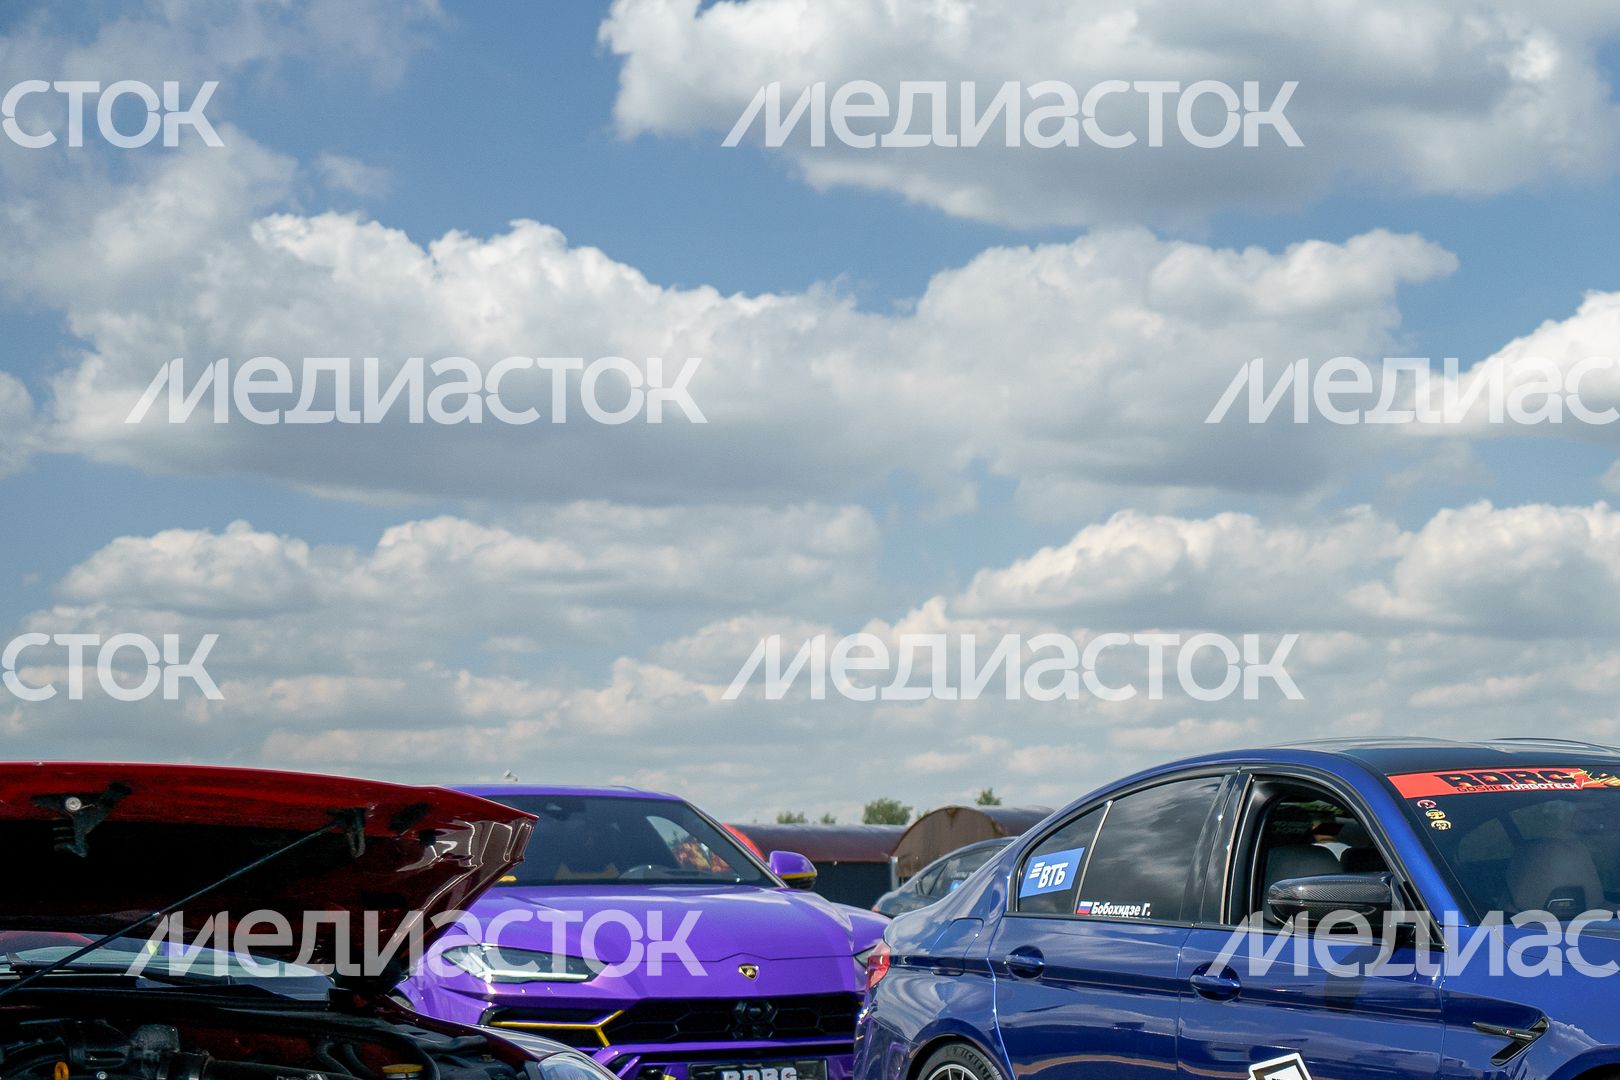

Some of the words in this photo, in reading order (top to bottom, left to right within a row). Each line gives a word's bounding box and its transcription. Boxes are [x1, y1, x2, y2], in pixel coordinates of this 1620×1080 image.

[1037, 861, 1070, 889] ВТБ
[1091, 901, 1142, 917] Бобохидзе
[1141, 902, 1152, 917] Г.
